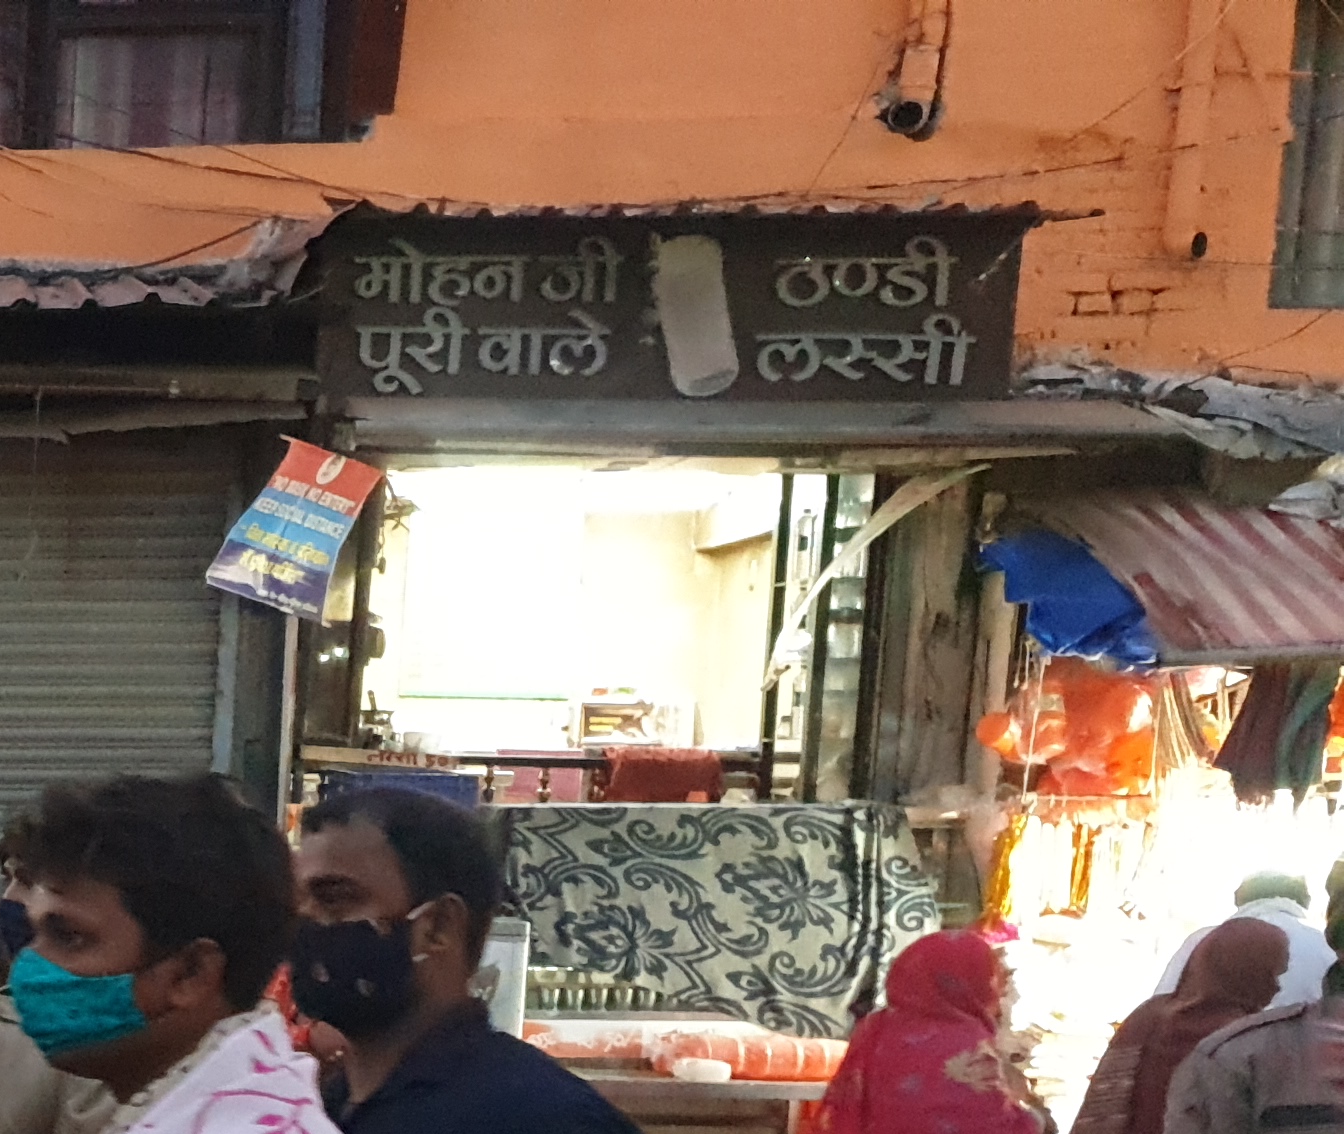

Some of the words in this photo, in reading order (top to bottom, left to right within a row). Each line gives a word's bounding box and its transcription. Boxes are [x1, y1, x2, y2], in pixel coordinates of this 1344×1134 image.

[353, 237, 530, 306] मोहन
[538, 235, 625, 303] जी
[775, 235, 961, 307] ठण्डी
[356, 305, 472, 395] पूरी
[477, 308, 612, 377] वाले
[756, 313, 977, 385] लस्सी
